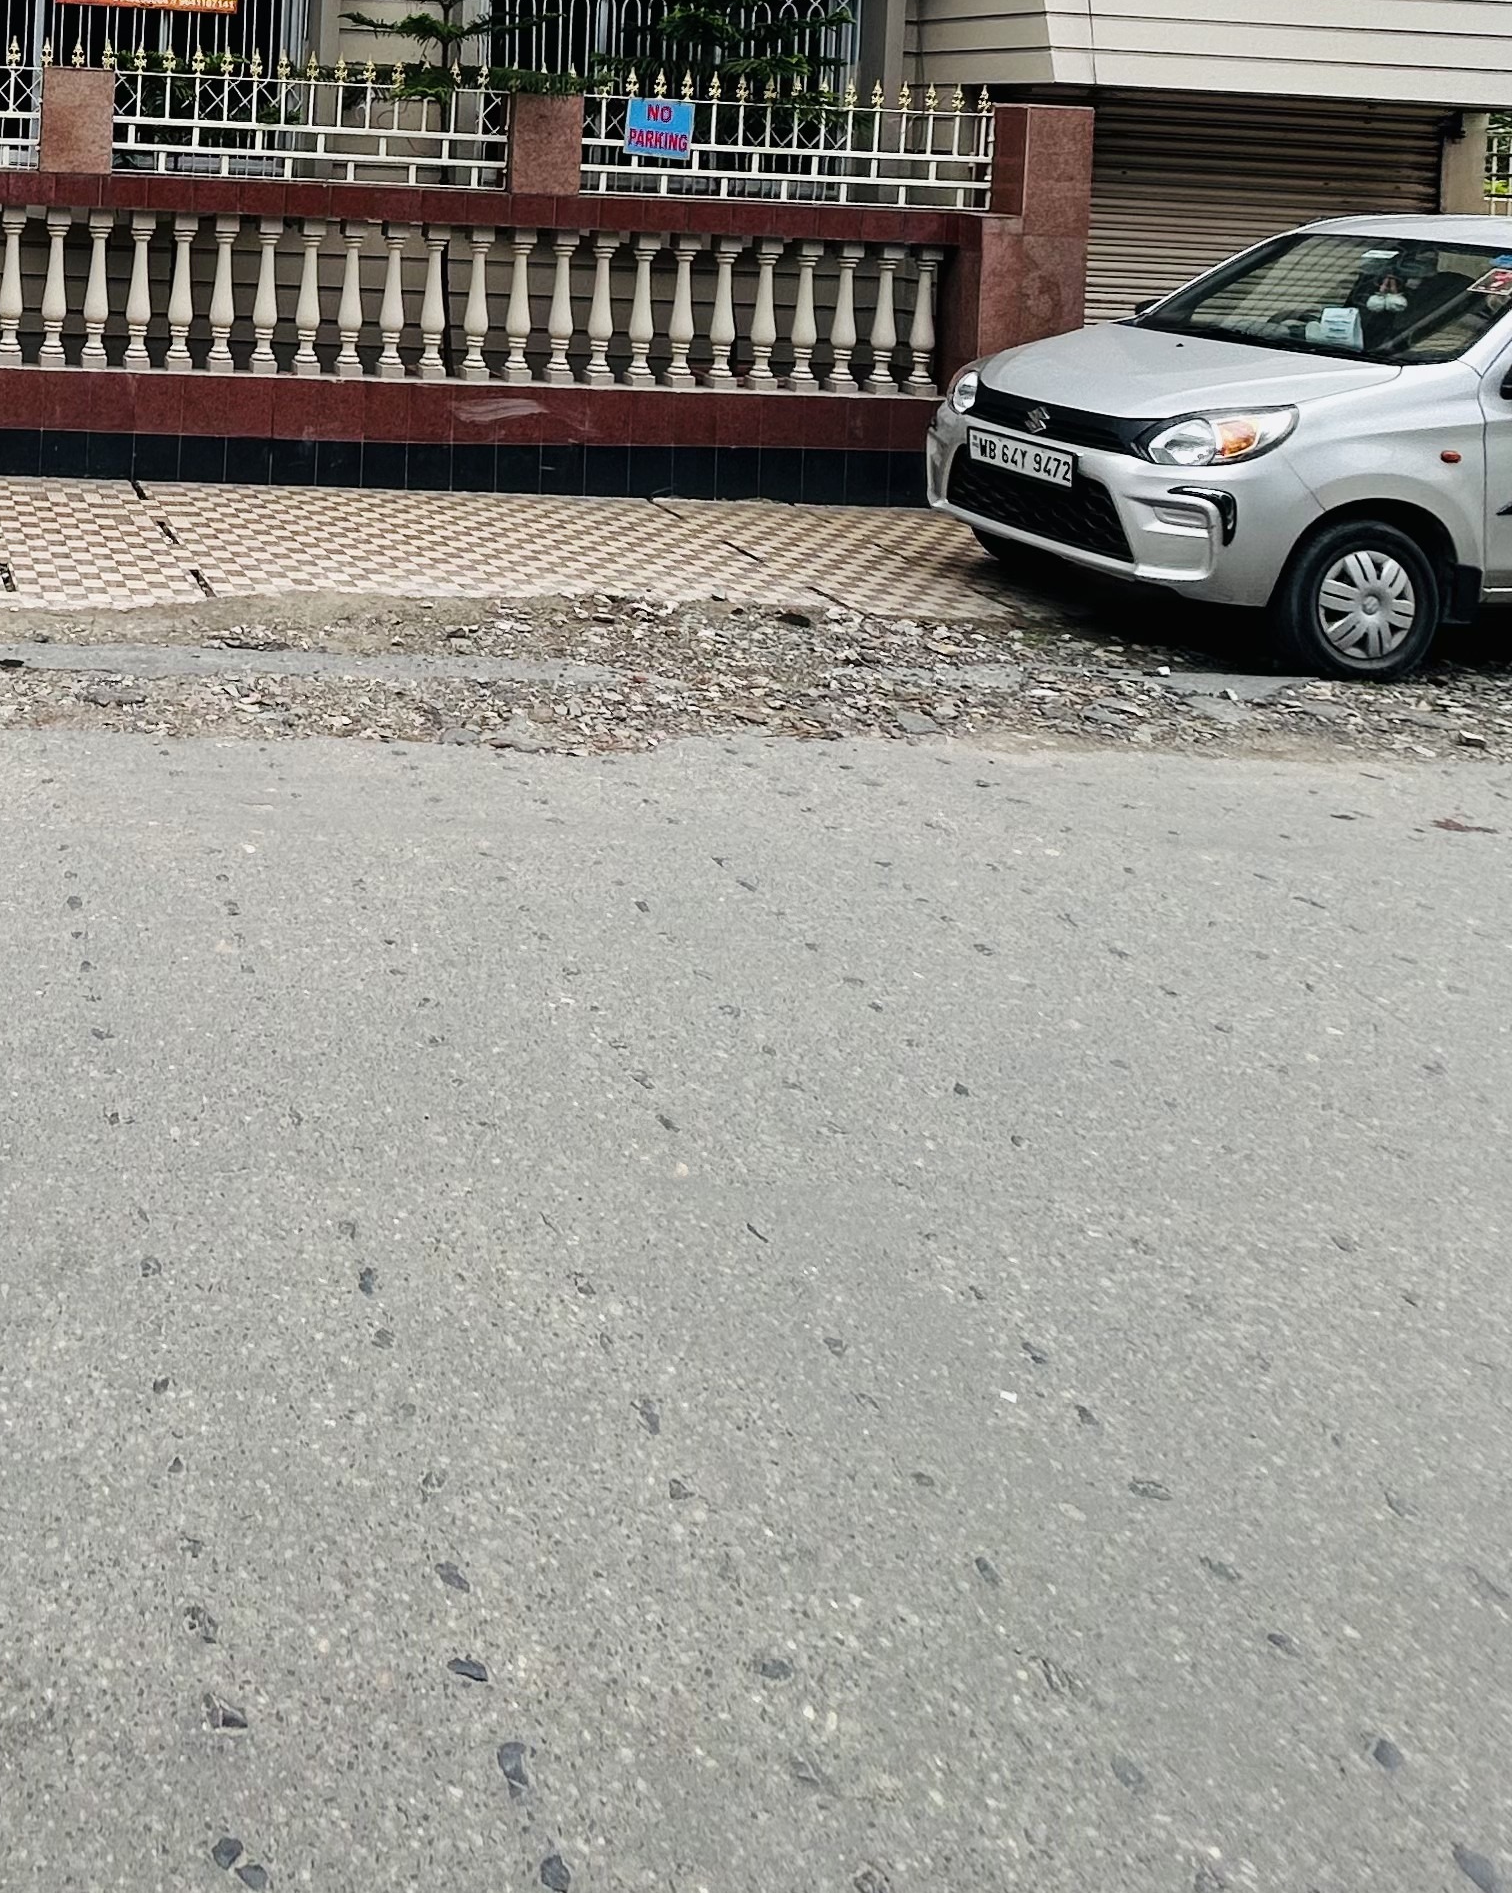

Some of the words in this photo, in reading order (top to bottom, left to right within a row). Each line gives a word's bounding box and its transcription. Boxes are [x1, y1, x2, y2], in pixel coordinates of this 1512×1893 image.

[647, 104, 672, 123] NO
[628, 128, 688, 153] PARKING
[979, 437, 997, 460] WB
[1001, 444, 1028, 470] 64Y
[1033, 453, 1071, 483] 9472
